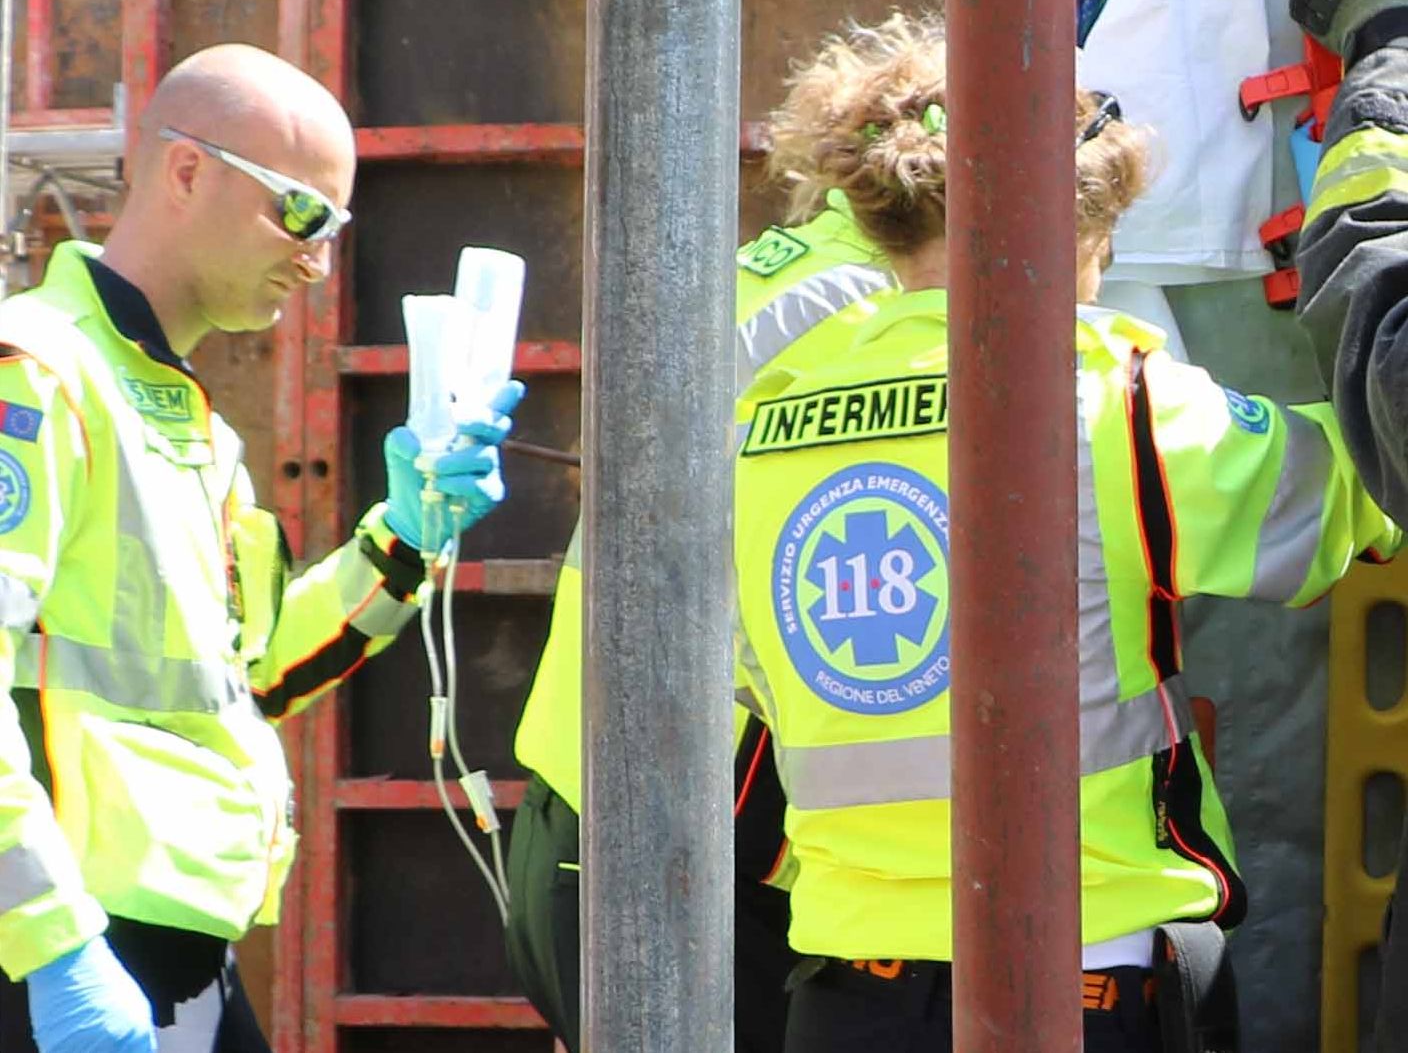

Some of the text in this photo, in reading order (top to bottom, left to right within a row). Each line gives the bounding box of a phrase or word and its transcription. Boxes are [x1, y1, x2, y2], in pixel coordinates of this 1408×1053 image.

[779, 542, 798, 635] SERVIZIO
[793, 478, 864, 540] URGENZA
[816, 655, 949, 705] REGIONE DEL VENETO
